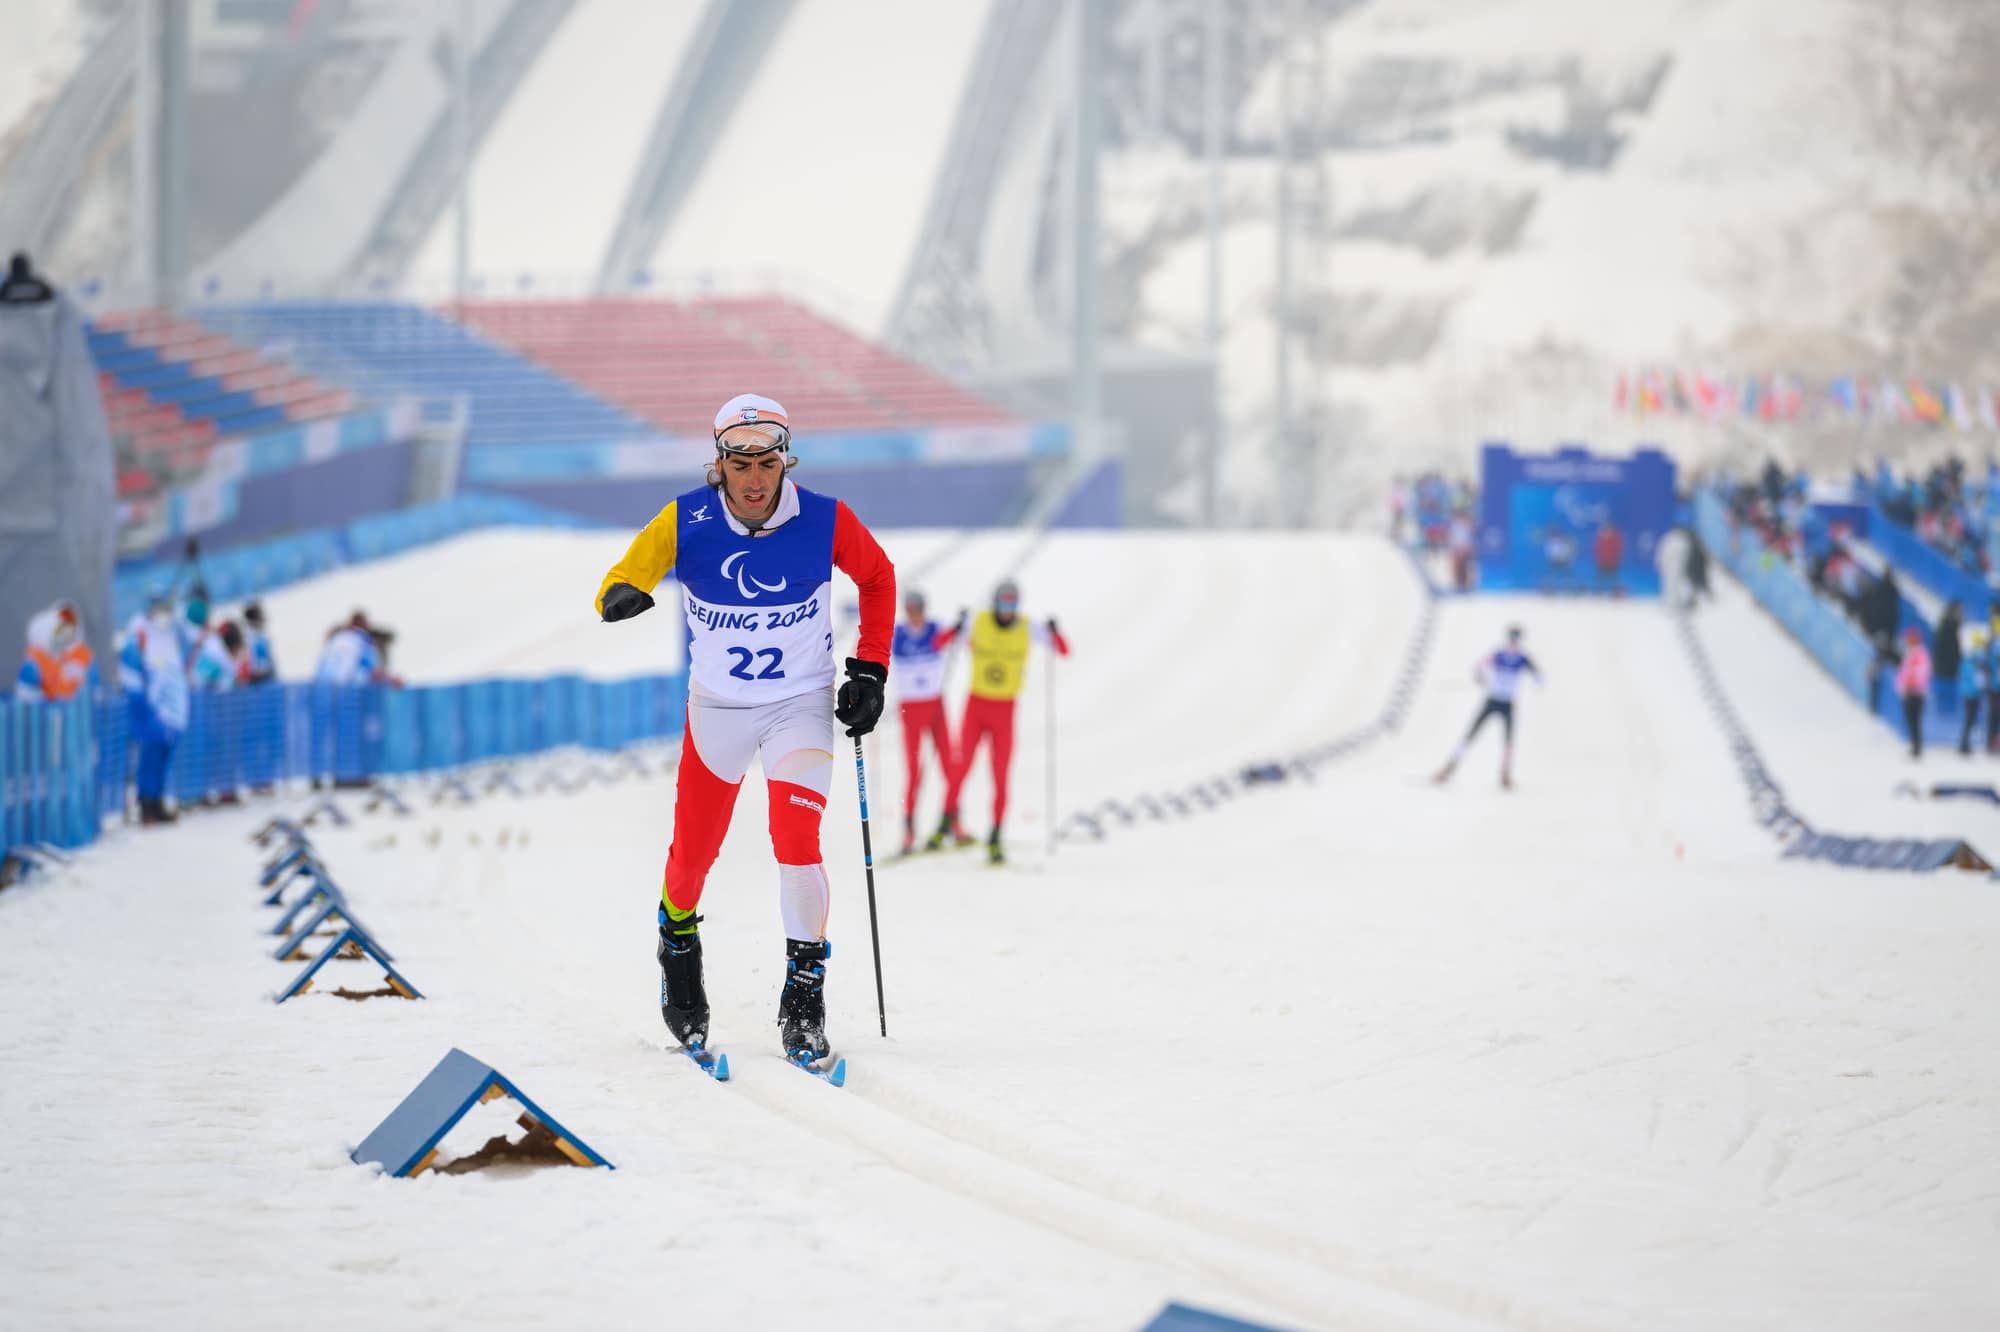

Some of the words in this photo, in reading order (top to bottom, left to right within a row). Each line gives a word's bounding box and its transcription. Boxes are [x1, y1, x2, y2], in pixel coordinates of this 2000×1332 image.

[688, 597, 759, 632] BEIJING
[766, 598, 820, 631] 2022
[726, 646, 786, 681] 22
